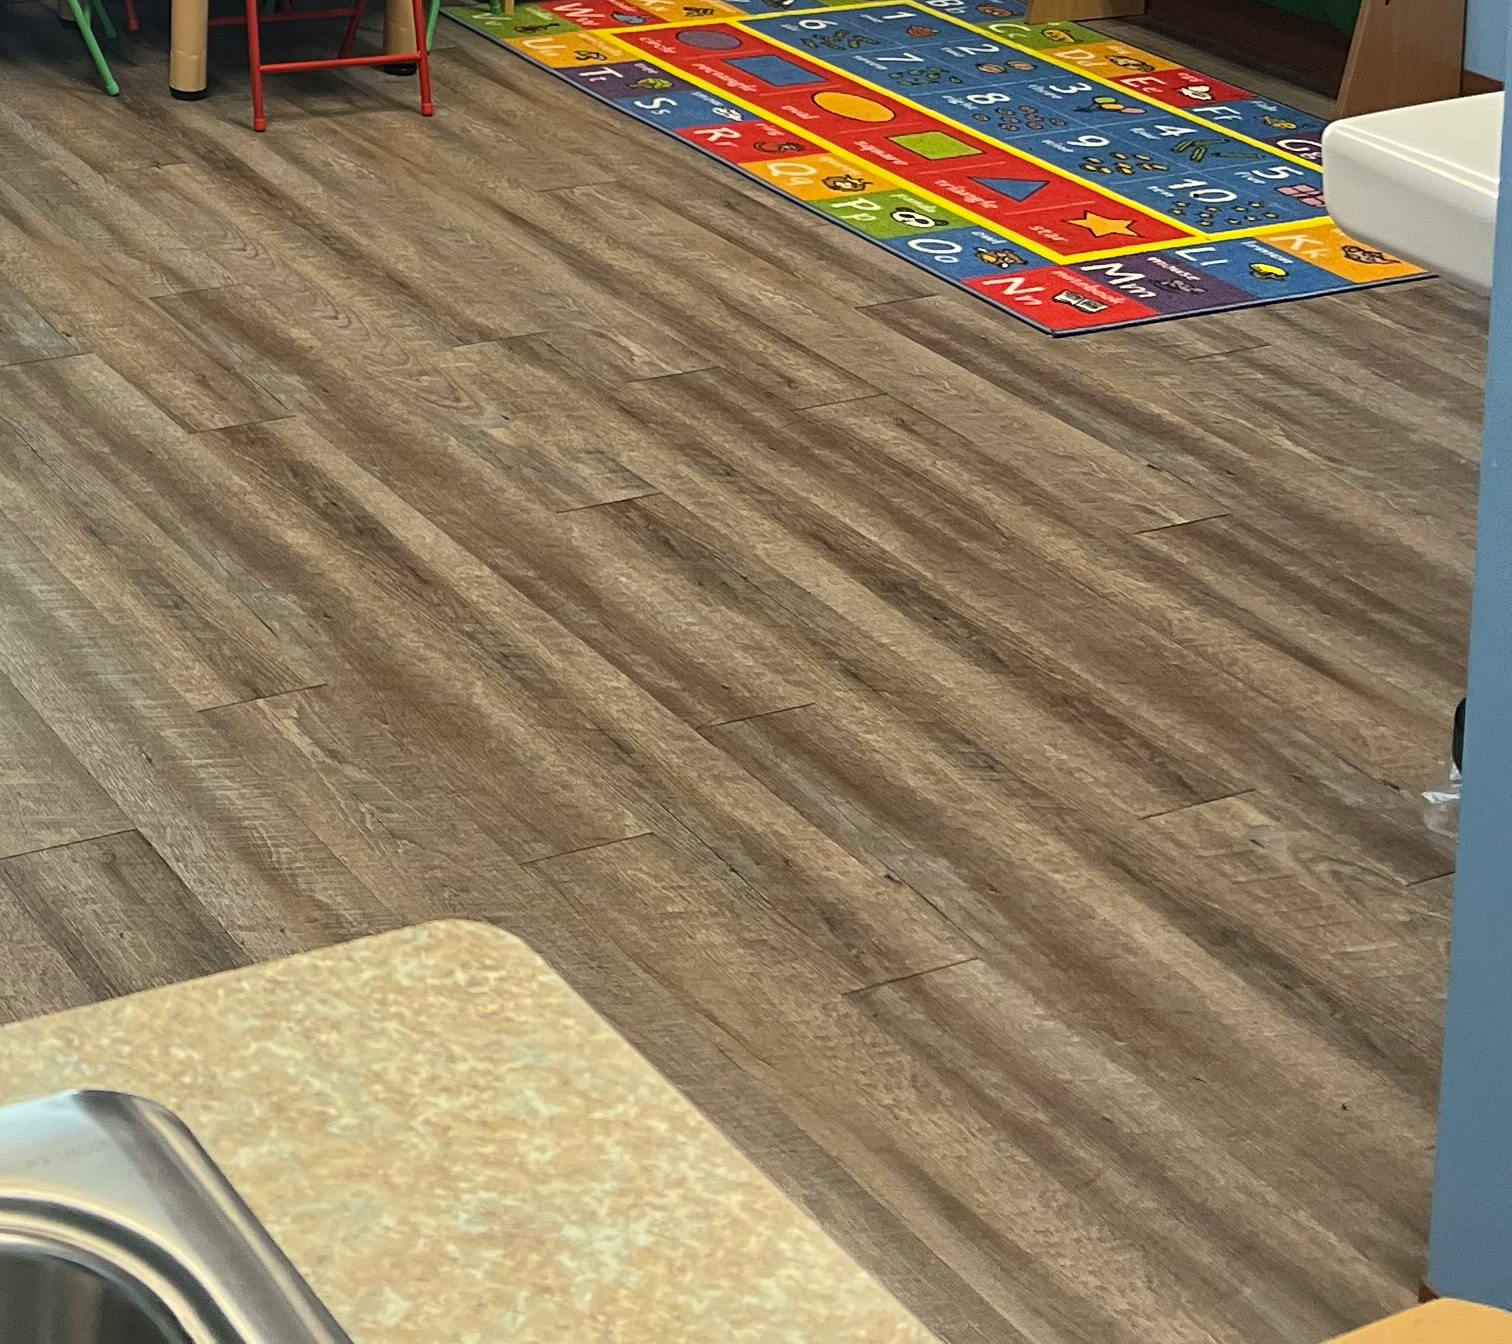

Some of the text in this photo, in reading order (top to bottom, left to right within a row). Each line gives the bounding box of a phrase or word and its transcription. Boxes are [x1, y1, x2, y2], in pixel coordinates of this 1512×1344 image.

[552, 2, 606, 26] Ww
[882, 11, 917, 20] 1
[798, 19, 838, 30] 6
[988, 23, 1031, 39] Cc
[638, 37, 677, 54] circle
[956, 43, 1000, 56] 2
[875, 52, 925, 62] 7
[1055, 48, 1108, 67] Dd
[578, 66, 624, 82] Tt
[691, 63, 758, 92] rectangle
[1048, 82, 1093, 94] 3
[1119, 76, 1168, 94] Ee
[634, 97, 678, 115] Ss
[966, 92, 1011, 105] 8
[1192, 105, 1243, 122] Ff
[693, 126, 742, 148] Rr
[1155, 123, 1198, 137] 4
[1066, 135, 1111, 147] 9
[853, 140, 909, 166] square
[767, 162, 818, 187] Qq
[1251, 165, 1304, 179] 5
[934, 179, 999, 209] triangle
[1167, 178, 1238, 203] 10
[830, 197, 882, 222] Pp
[1028, 225, 1069, 242] star
[907, 238, 963, 264] Oo
[1240, 240, 1294, 264] lemon
[1270, 234, 1330, 259] Kk
[1147, 256, 1201, 281] mouse
[1051, 270, 1127, 305] notebook
[1080, 262, 1157, 299] Mm
[981, 276, 1046, 306] Nn
